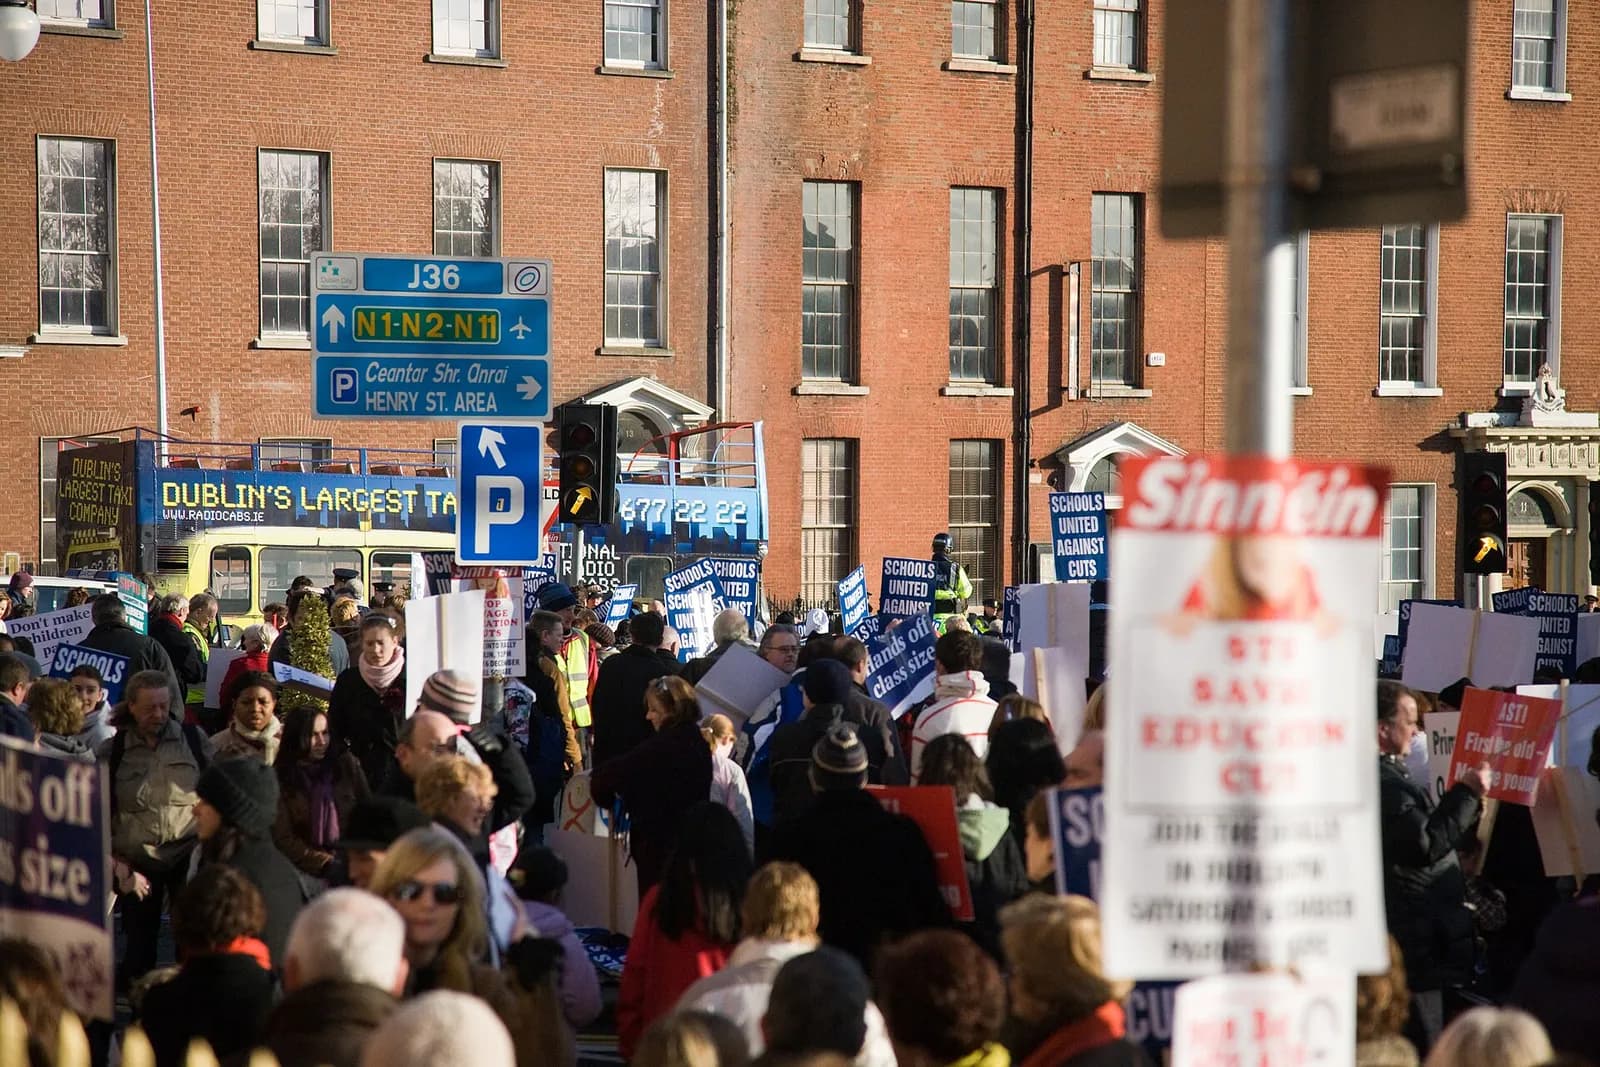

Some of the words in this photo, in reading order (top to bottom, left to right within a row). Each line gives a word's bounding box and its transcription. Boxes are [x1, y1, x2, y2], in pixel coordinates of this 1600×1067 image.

[408, 263, 460, 290] J36
[365, 361, 429, 383] Ceantar
[432, 362, 461, 384] Shr.
[336, 373, 354, 398] P
[365, 391, 419, 412] HENRY
[425, 391, 449, 412] ST.
[454, 391, 498, 412] AREA
[625, 430, 634, 438] 13
[72, 457, 121, 482] DUBLIN'S
[59, 478, 106, 502] LARGEST
[108, 483, 134, 506] TAXI
[162, 482, 292, 510] DUBLIN'S
[301, 486, 418, 514] LARGEST
[69, 501, 119, 526] COMPANY
[621, 498, 666, 522] 677
[675, 499, 708, 523] 22
[716, 500, 747, 524] 22
[1051, 494, 1103, 513] SCHOOLS
[162, 509, 265, 522] WWW.RADIOCABS.IE
[475, 475, 525, 554] P
[1058, 516, 1099, 535] UNITED
[1057, 537, 1104, 556] AGAINST
[562, 560, 615, 577] RDIO
[665, 560, 714, 593] SCHOOLS
[711, 561, 756, 579] CHOOLS
[884, 559, 936, 579] SCHOOLS
[1068, 559, 1097, 578] CUTS
[888, 580, 929, 598] UNITED
[1528, 595, 1577, 614] SCHOOLS
[11, 616, 49, 635] Don't
[53, 609, 91, 628] make
[908, 614, 931, 644] off
[1539, 616, 1571, 634] NITED
[28, 625, 83, 644] hildren
[1536, 638, 1574, 655] GAINST
[873, 665, 908, 699] class
[907, 645, 937, 674] size
[1513, 740, 1536, 760] old
[40, 762, 96, 829] off
[20, 833, 91, 906] size
